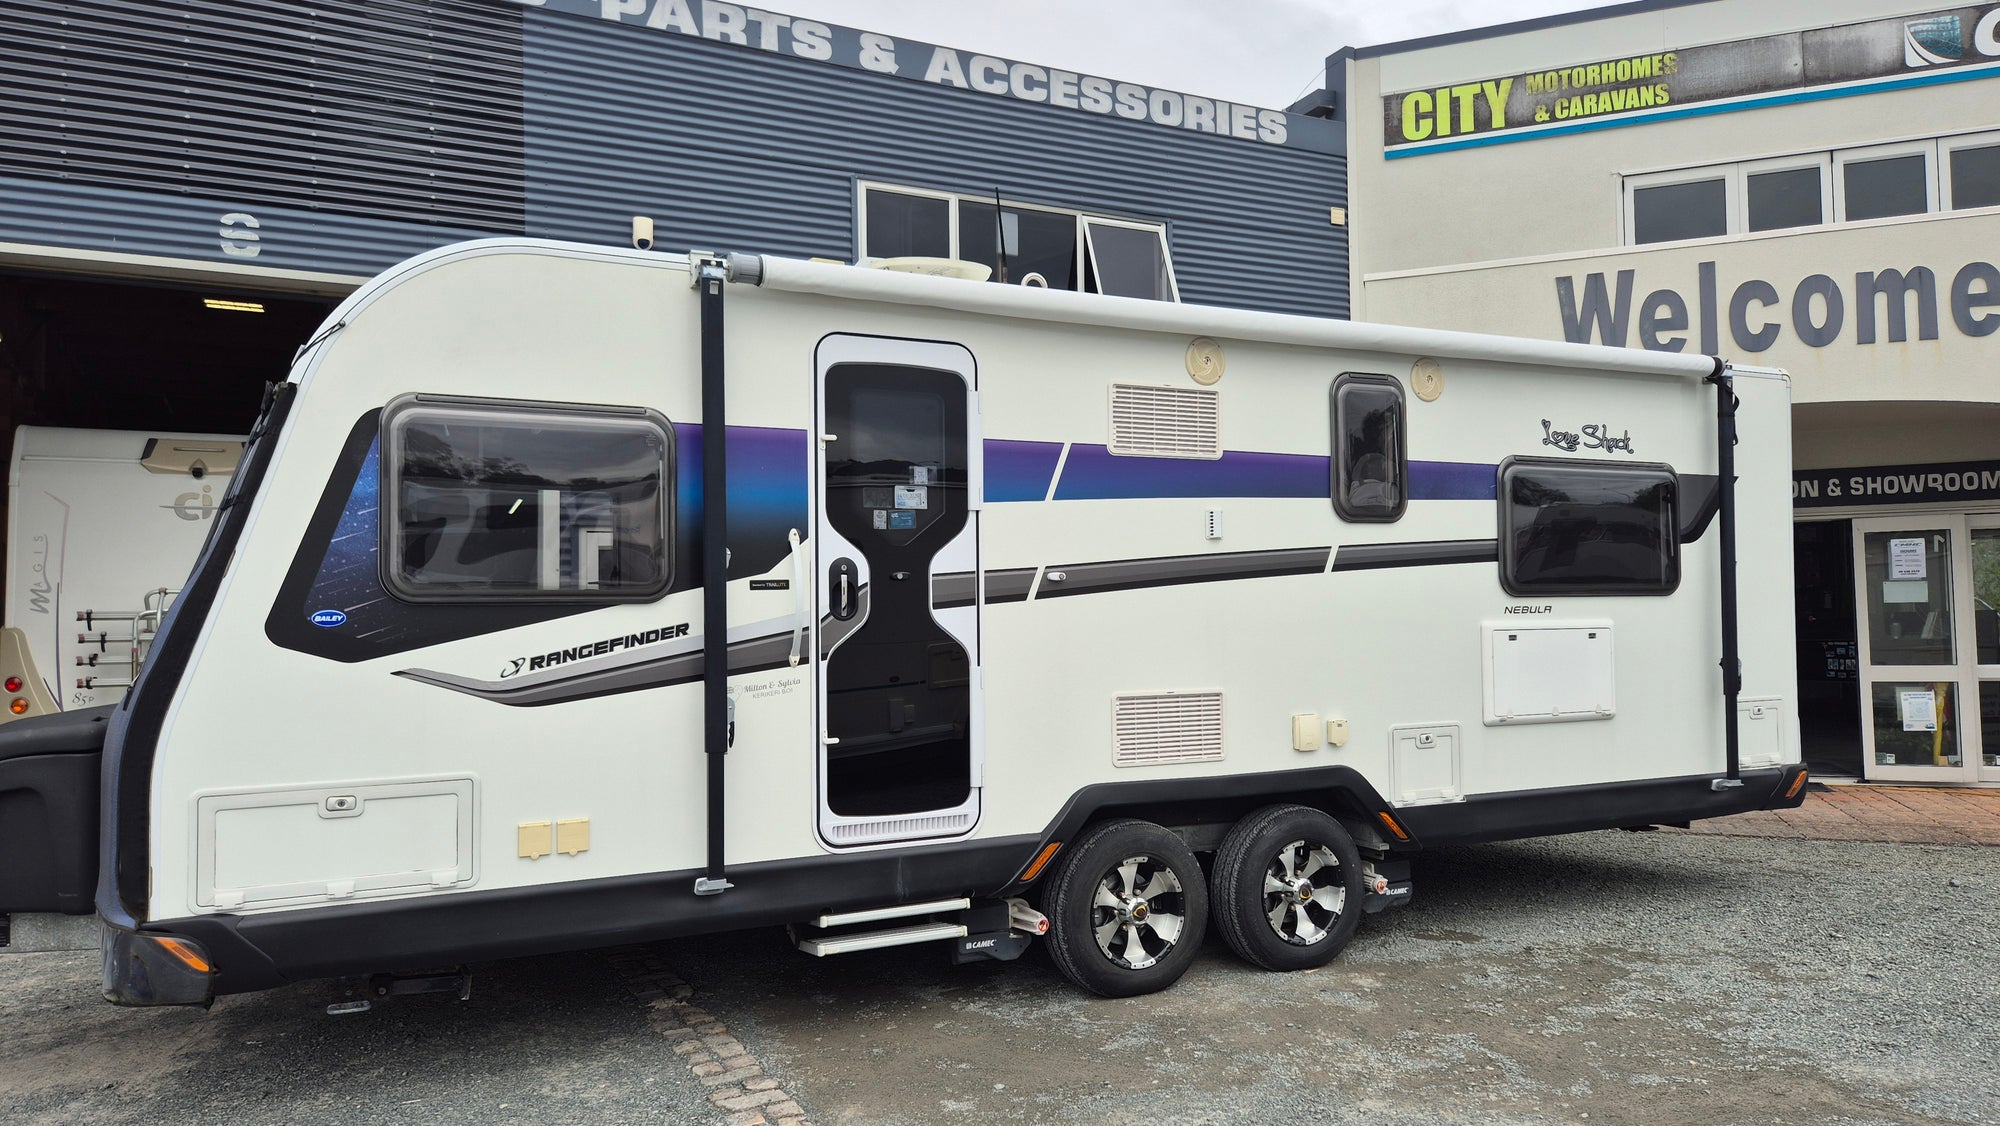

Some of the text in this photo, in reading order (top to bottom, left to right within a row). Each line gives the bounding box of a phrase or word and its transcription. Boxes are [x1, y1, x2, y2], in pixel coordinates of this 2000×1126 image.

[601, 0, 1288, 145] PARTS & ACCESSORIES
[1525, 52, 1679, 96] MOTORHOMES
[1401, 78, 1514, 141] CITY
[1534, 83, 1670, 123] & CARAVANS
[219, 212, 261, 258] 8
[1555, 261, 2000, 356] Welcome
[1541, 418, 1635, 454] Love Shack
[1827, 478, 1842, 497] &
[1850, 470, 2000, 496] SHOWROOM
[1504, 605, 1552, 614] NEBULA
[529, 622, 690, 672] RANGEFINDER
[744, 684, 767, 693] Milton
[778, 678, 801, 688] Sylvia
[972, 939, 995, 949] CAMEC
